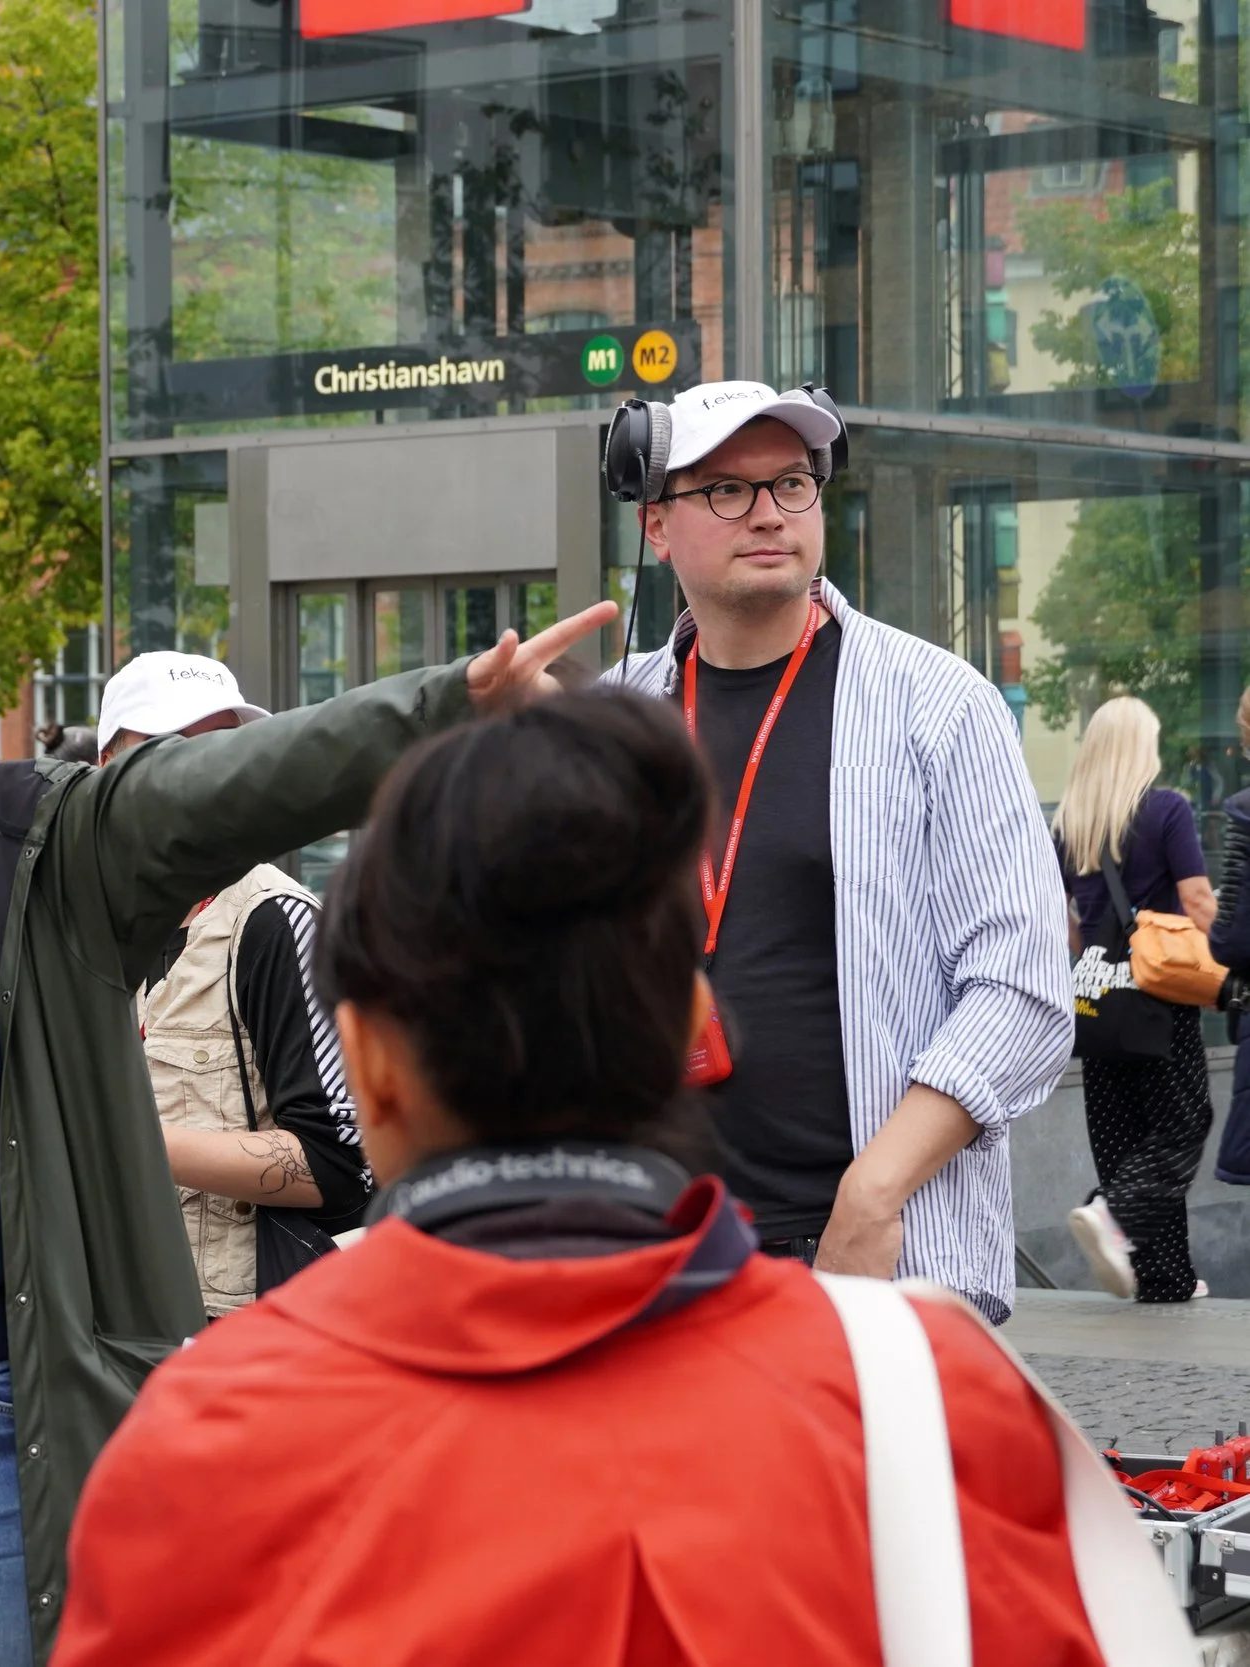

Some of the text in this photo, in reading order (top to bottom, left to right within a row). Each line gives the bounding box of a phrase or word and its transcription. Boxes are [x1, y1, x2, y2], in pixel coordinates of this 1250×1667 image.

[314, 345, 671, 395] Christianshavn M1 M2
[751, 695, 782, 764] www.stromma.com
[719, 818, 741, 892] www.stromma.com
